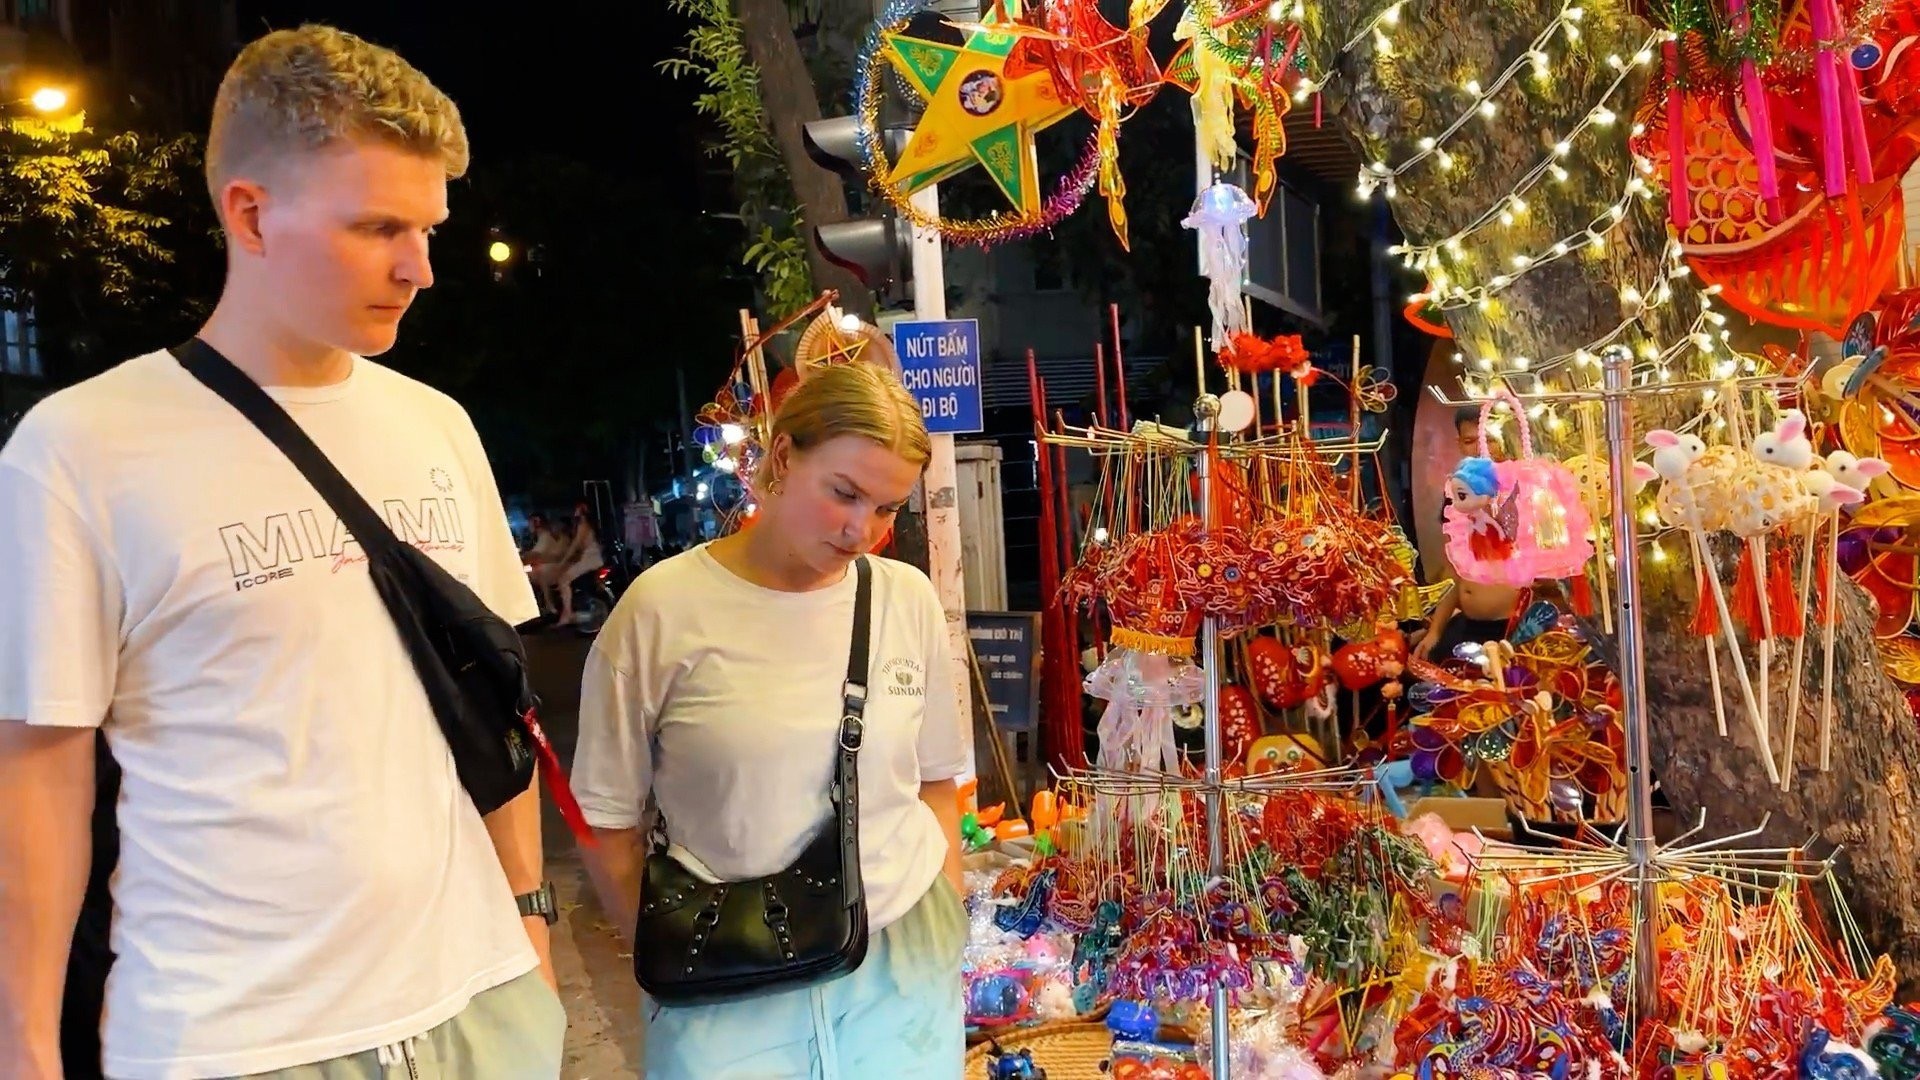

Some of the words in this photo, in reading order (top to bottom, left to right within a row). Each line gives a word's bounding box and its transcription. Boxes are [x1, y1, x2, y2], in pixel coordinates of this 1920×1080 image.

[906, 332, 935, 358] NÚT
[937, 328, 968, 356] BẤM
[902, 368, 931, 390] CHO
[933, 359, 976, 388] NGƯỜI
[922, 397, 936, 418] ĐI
[939, 392, 959, 419] BỘ
